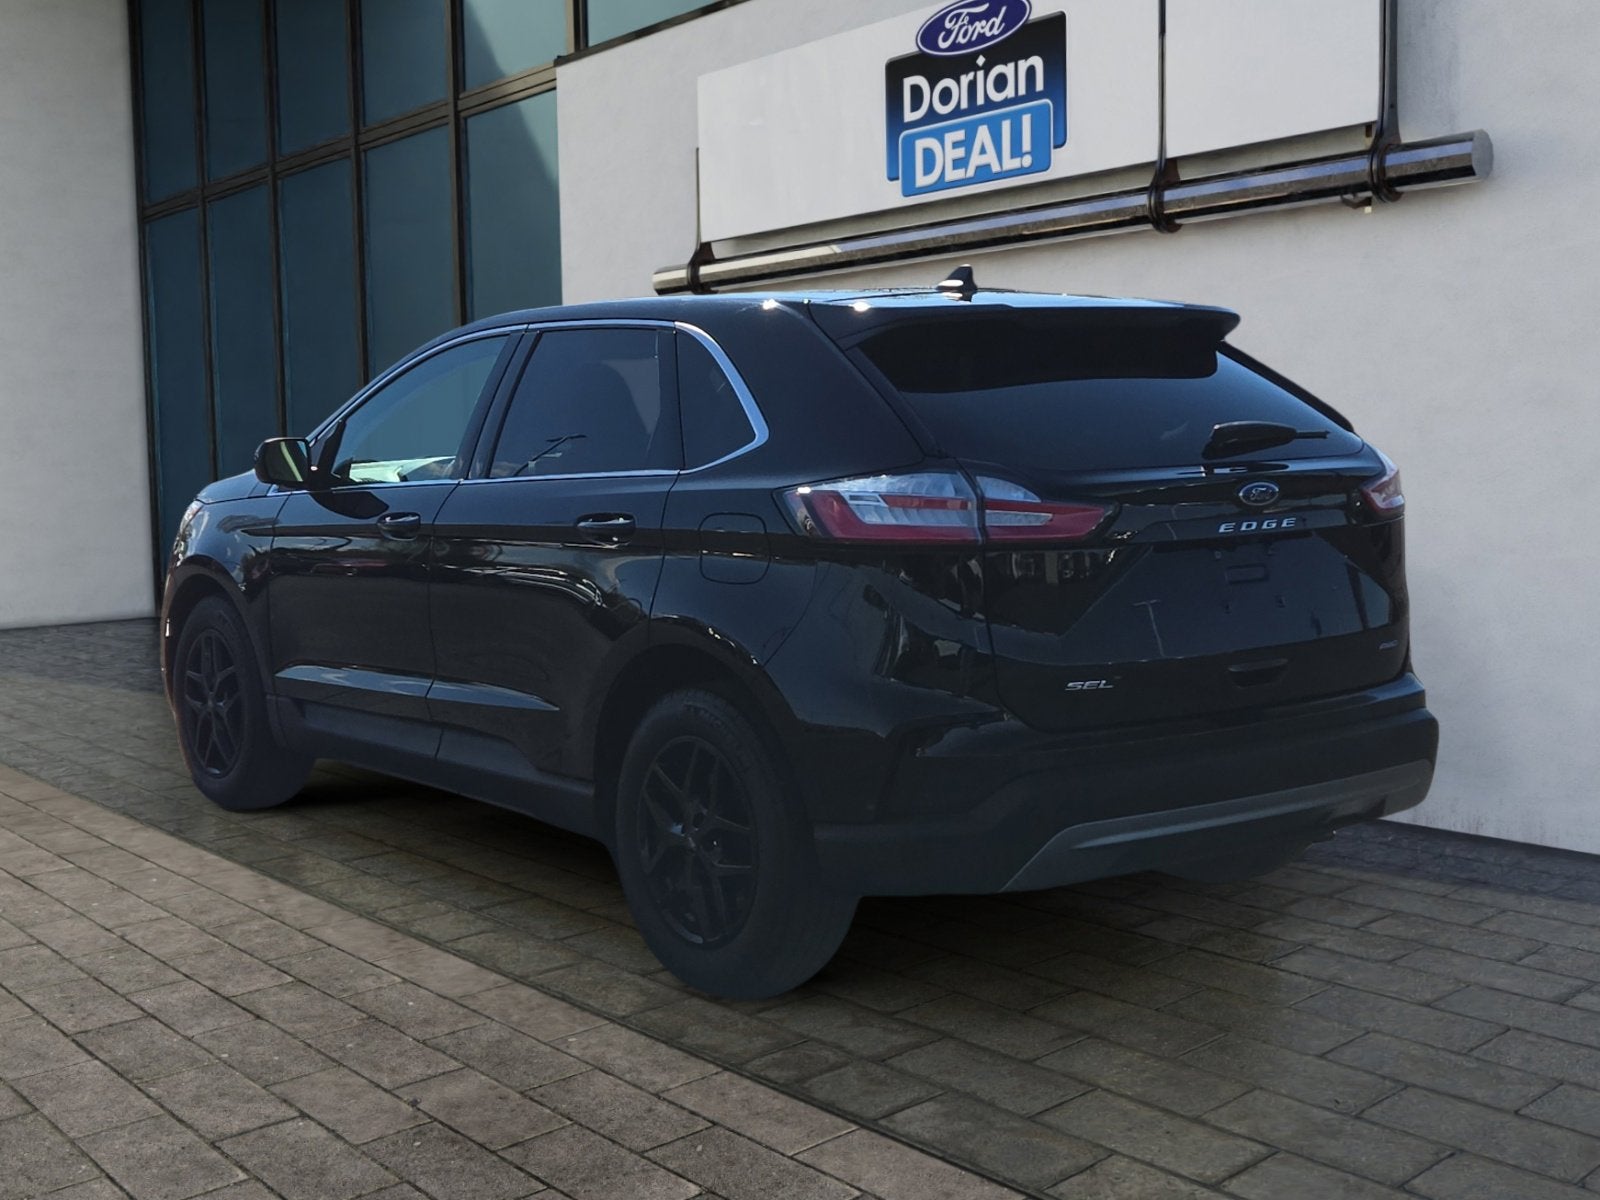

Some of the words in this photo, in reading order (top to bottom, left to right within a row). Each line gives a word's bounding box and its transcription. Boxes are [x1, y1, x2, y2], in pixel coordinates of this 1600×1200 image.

[937, 2, 1007, 49] Ford
[902, 54, 1044, 123] Dorian
[914, 113, 1033, 188] DEAL!
[1218, 517, 1297, 533] EDGE
[1064, 679, 1115, 691] SEL
